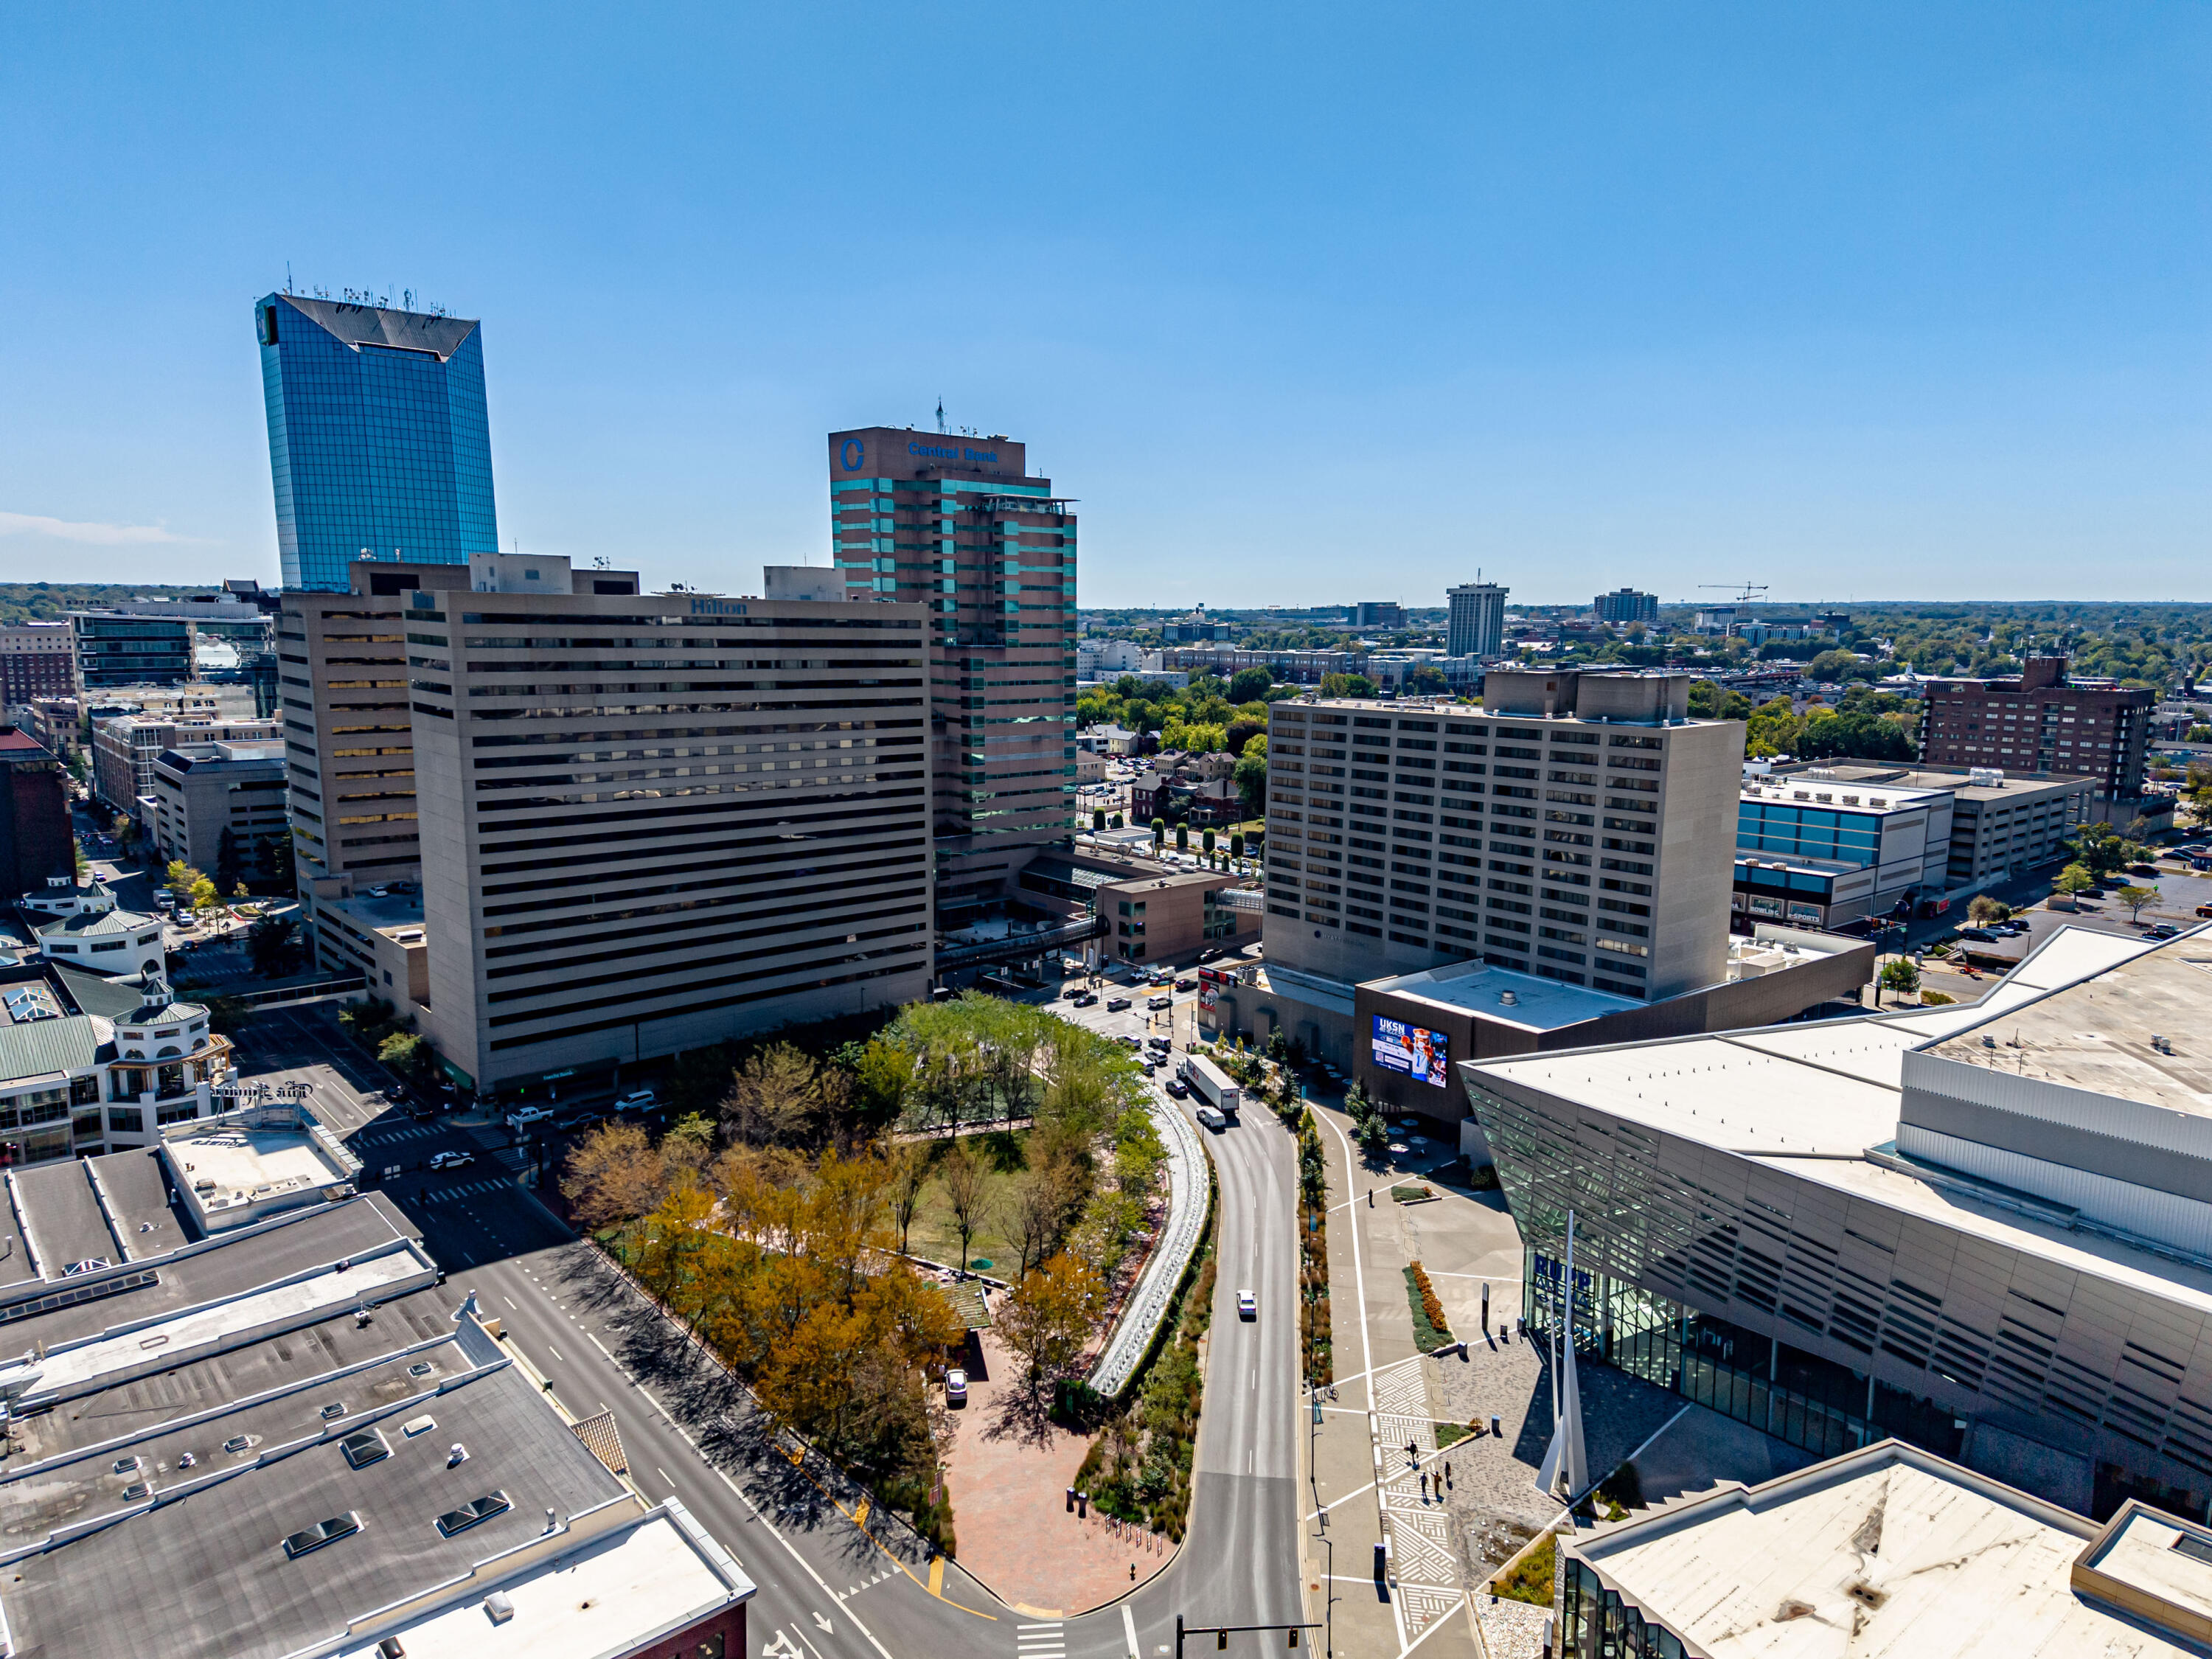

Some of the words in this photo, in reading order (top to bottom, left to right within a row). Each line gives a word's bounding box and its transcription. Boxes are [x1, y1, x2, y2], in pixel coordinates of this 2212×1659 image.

[908, 442, 959, 459] Central
[964, 448, 998, 463] Bank
[691, 598, 748, 614] Hilton
[1750, 906, 1779, 916] BOWLING
[1380, 1018, 1405, 1034] UKSN
